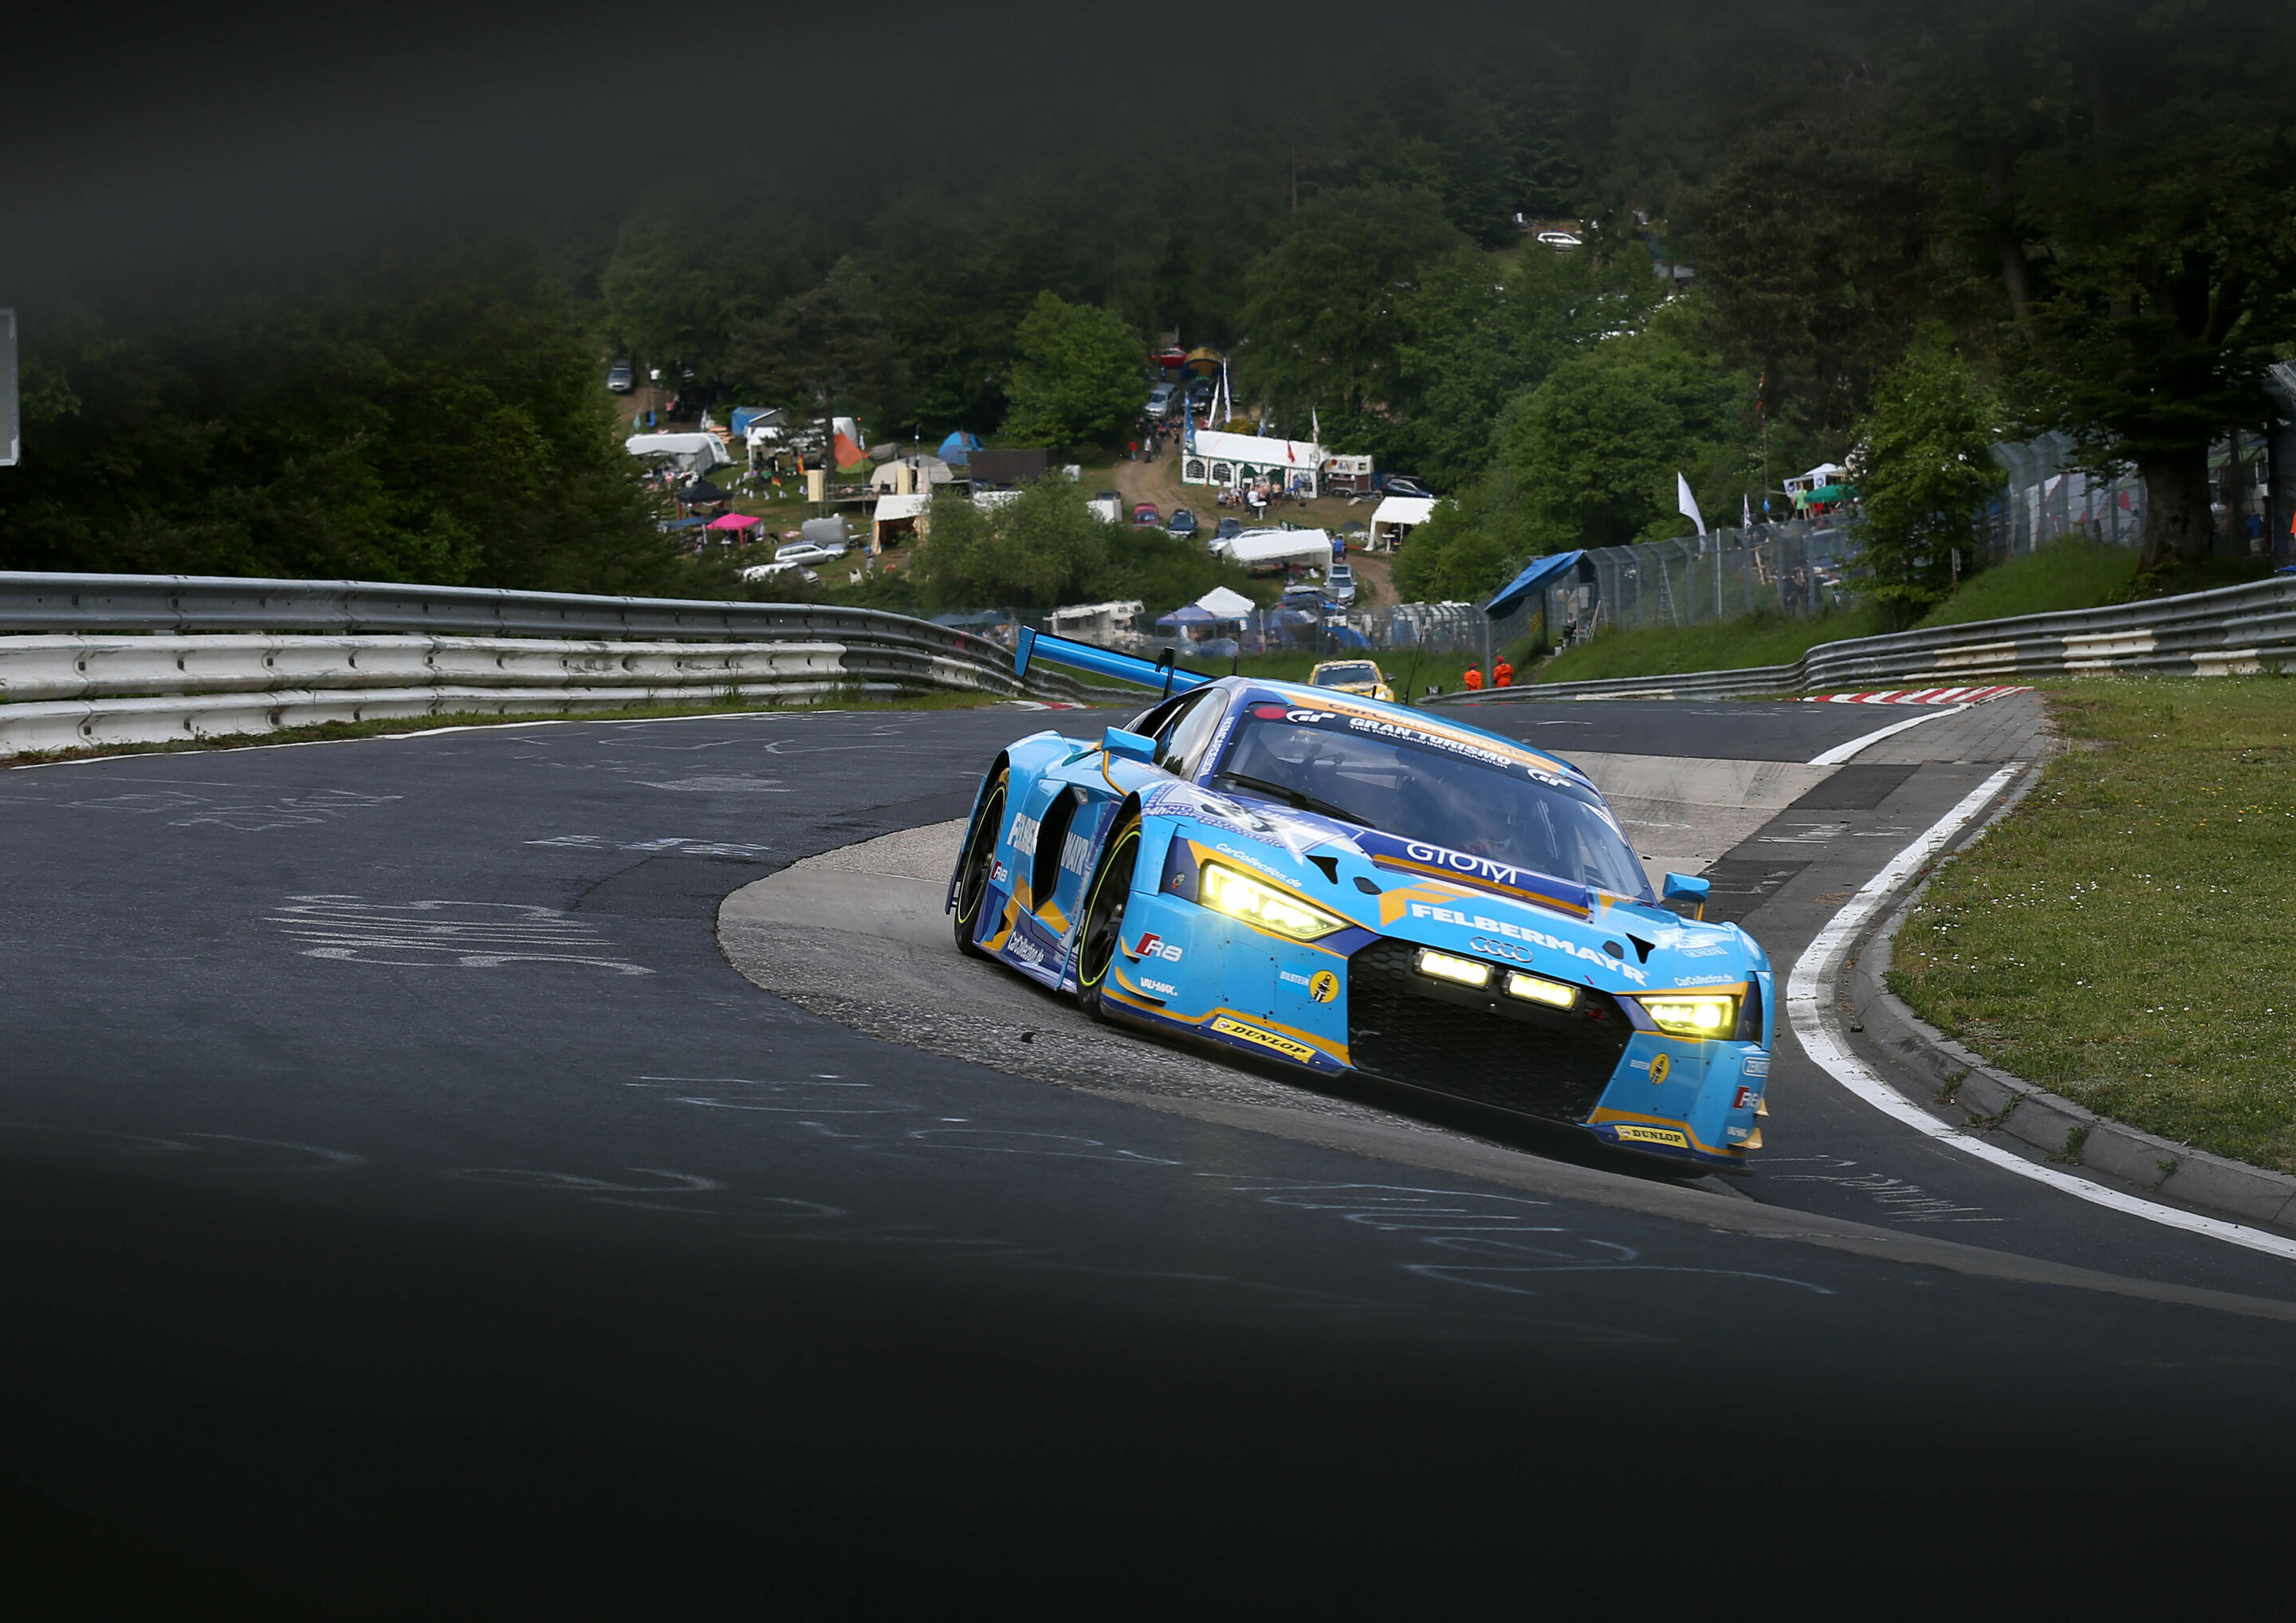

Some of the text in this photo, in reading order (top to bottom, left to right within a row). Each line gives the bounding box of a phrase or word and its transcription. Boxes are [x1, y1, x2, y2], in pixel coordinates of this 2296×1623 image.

[1350, 717, 1512, 765] GRAN TURISMO
[1372, 728, 1401, 738] REAL
[1402, 735, 1446, 749] DRIVING
[1448, 748, 1508, 769] SIMULATOR
[1215, 843, 1303, 888] CarCollection.de
[1143, 939, 1183, 962] R8
[1411, 902, 1648, 987] FELBERMAYR
[1280, 970, 1310, 986] BILSTEIN
[1231, 1026, 1307, 1054] DUNLOP
[1632, 1130, 1681, 1142] DUNLOP
